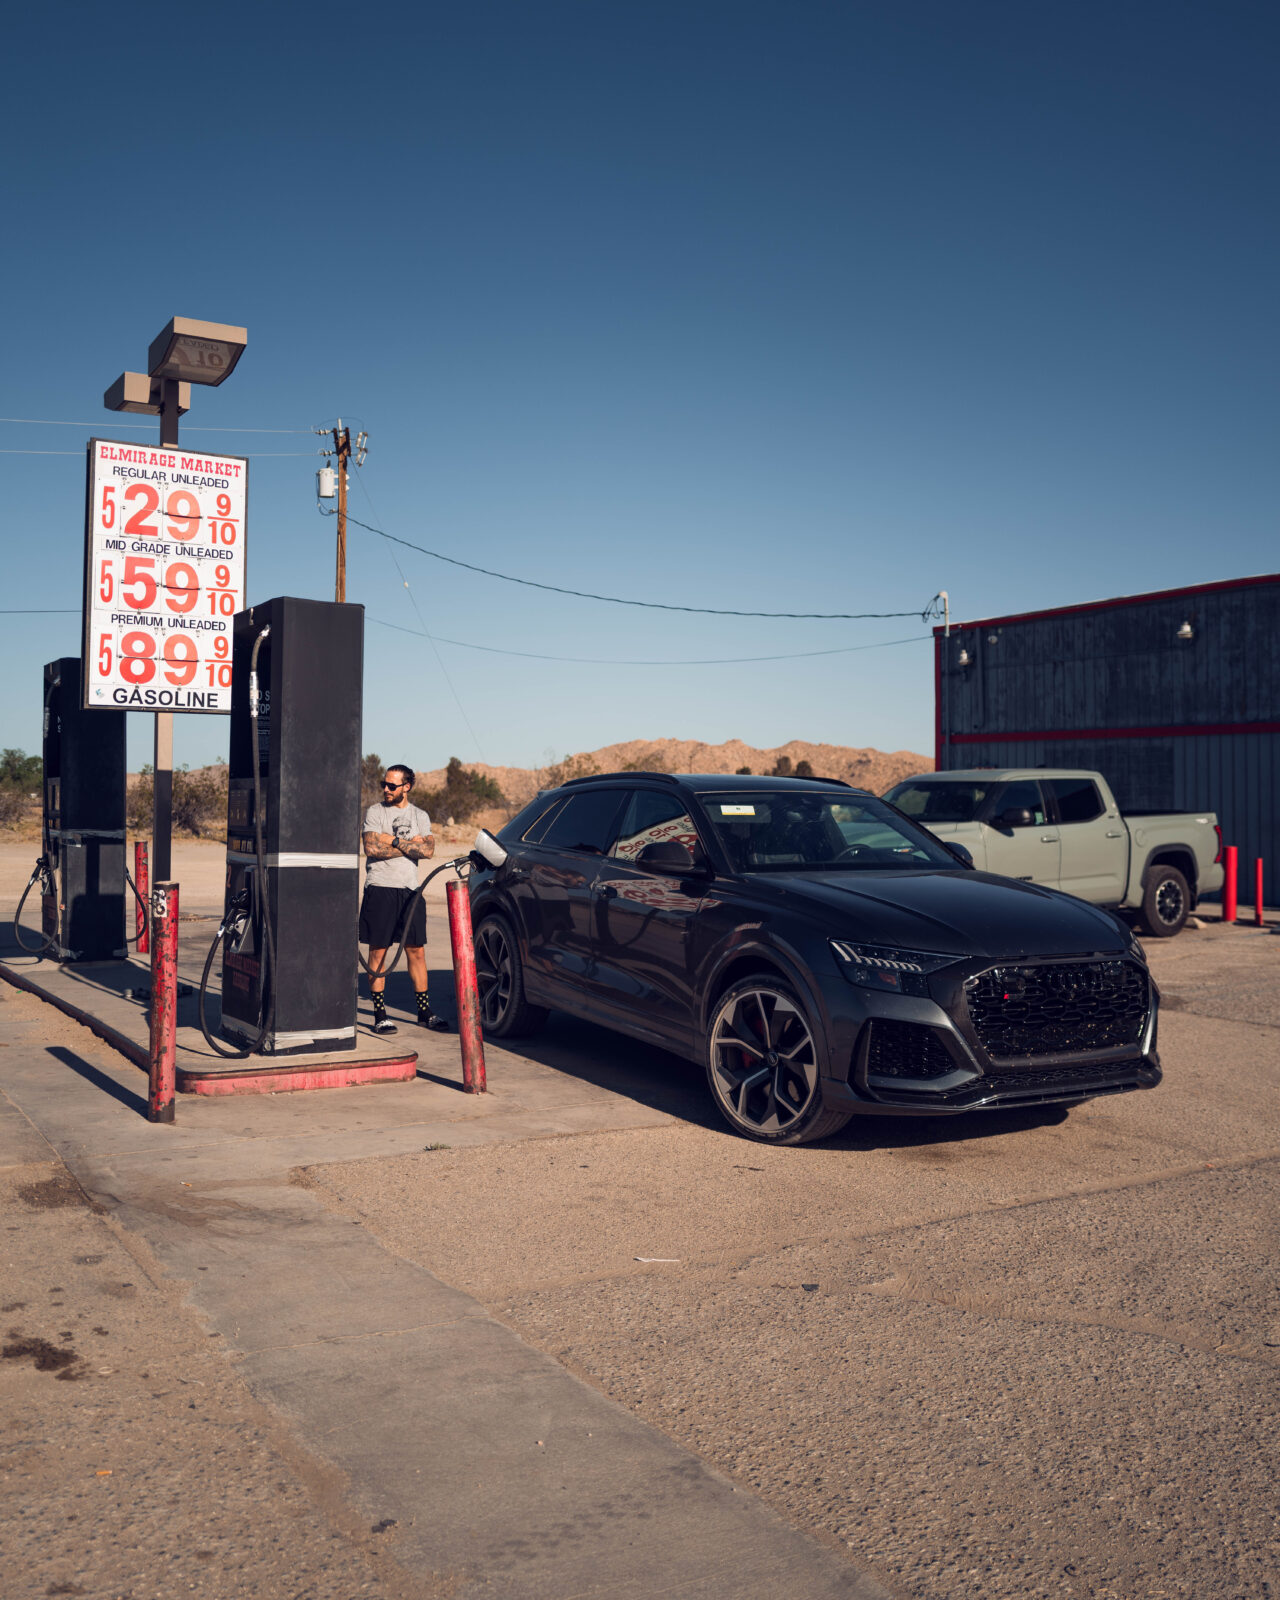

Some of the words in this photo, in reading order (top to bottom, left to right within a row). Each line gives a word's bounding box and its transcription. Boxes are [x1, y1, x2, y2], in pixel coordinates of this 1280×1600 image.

[100, 446, 176, 468] ELMIRAGE
[181, 457, 241, 477] MARKET
[113, 466, 166, 481] REGULAR
[171, 473, 229, 489] UNLEADED
[105, 539, 126, 550] MID
[131, 542, 170, 555] GRADE
[175, 546, 233, 560] UNLEADED
[111, 614, 163, 627] PREMIUM
[167, 618, 226, 631] UNLEADED
[113, 688, 218, 708] GASOLINE
